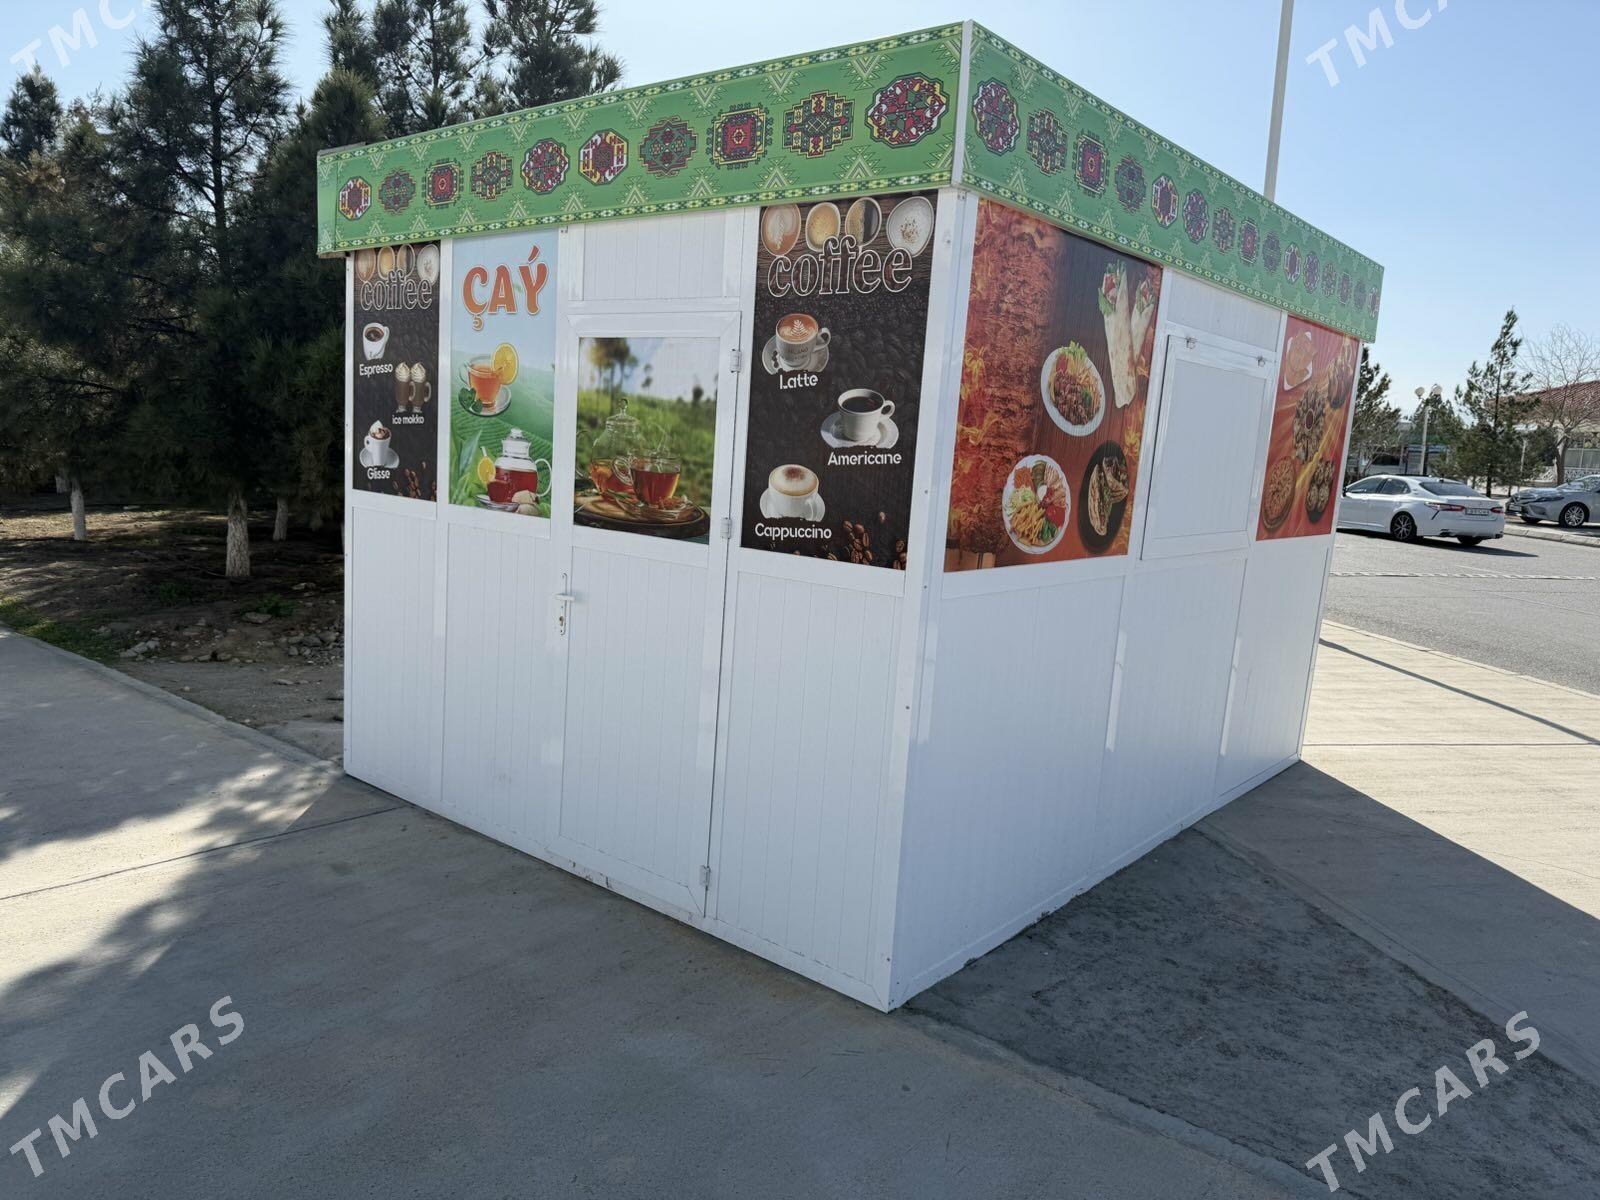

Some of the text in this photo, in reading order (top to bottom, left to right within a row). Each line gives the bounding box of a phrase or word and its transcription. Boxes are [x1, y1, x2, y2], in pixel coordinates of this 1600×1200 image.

[767, 234, 913, 298] coffee
[360, 268, 433, 311] coffee
[462, 244, 549, 331] ÇAÝ
[359, 363, 394, 378] Espresso
[779, 373, 819, 390] Latte
[754, 522, 833, 541] Cappuccino
